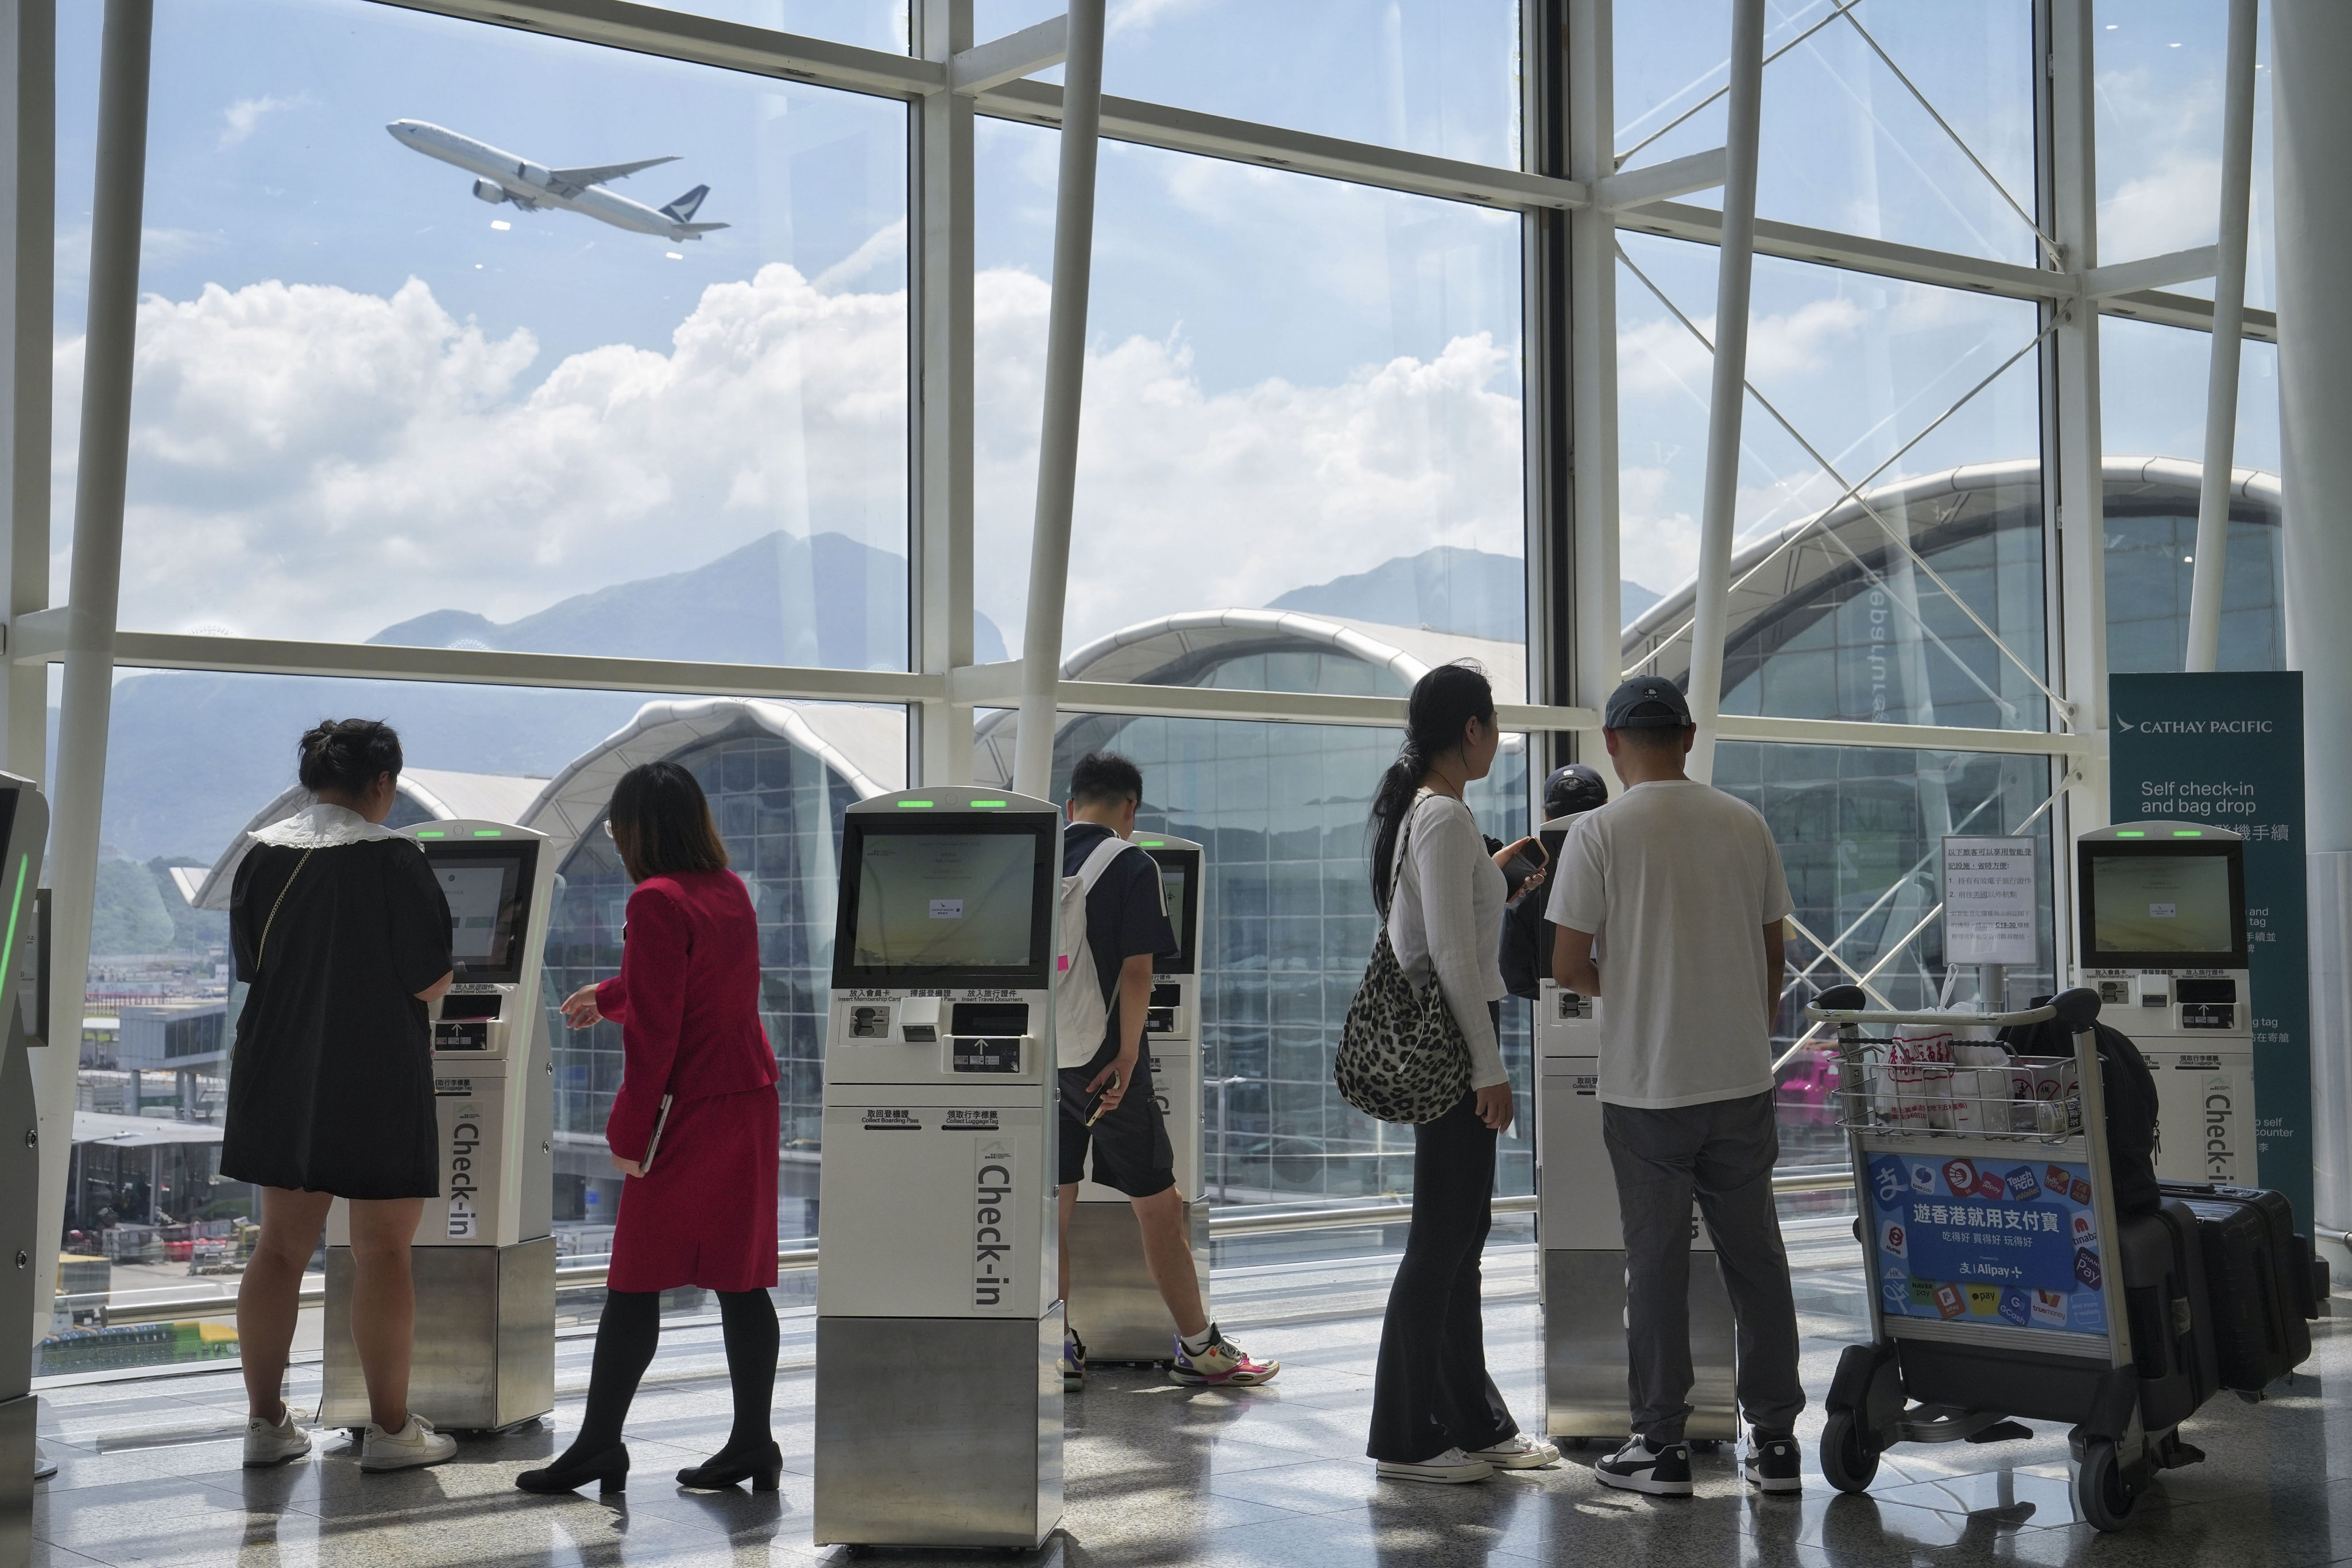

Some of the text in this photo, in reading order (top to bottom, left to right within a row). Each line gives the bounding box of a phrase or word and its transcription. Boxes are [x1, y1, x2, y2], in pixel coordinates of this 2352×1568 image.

[2140, 721, 2272, 733] CATHAY PACIFIC
[2141, 781, 2254, 796] Self check-in
[2141, 799, 2256, 816] and bag drop
[2249, 907, 2268, 916] and
[2250, 917, 2266, 927] tag
[850, 989, 891, 997] 放入會員卡
[967, 989, 1017, 997] 放入旅行證件
[2261, 1017, 2278, 1028] tag
[867, 1110, 910, 1118] 取回登機證
[947, 1110, 998, 1118] 領取行李標籤
[2264, 1118, 2283, 1126] self
[450, 1123, 479, 1235] Check-in
[2006, 1171, 2032, 1186] Touch
[1913, 1203, 2060, 1233] 遊香港就用支付寶
[976, 1165, 1011, 1305] Check-in
[1943, 1231, 2033, 1248] 吃得好 買得好 玩得好
[2076, 1258, 2100, 1283] Pay
[1979, 1292, 1995, 1302] pay
[2000, 1304, 2025, 1325] GCash
[2033, 1305, 2065, 1321] truemoney
